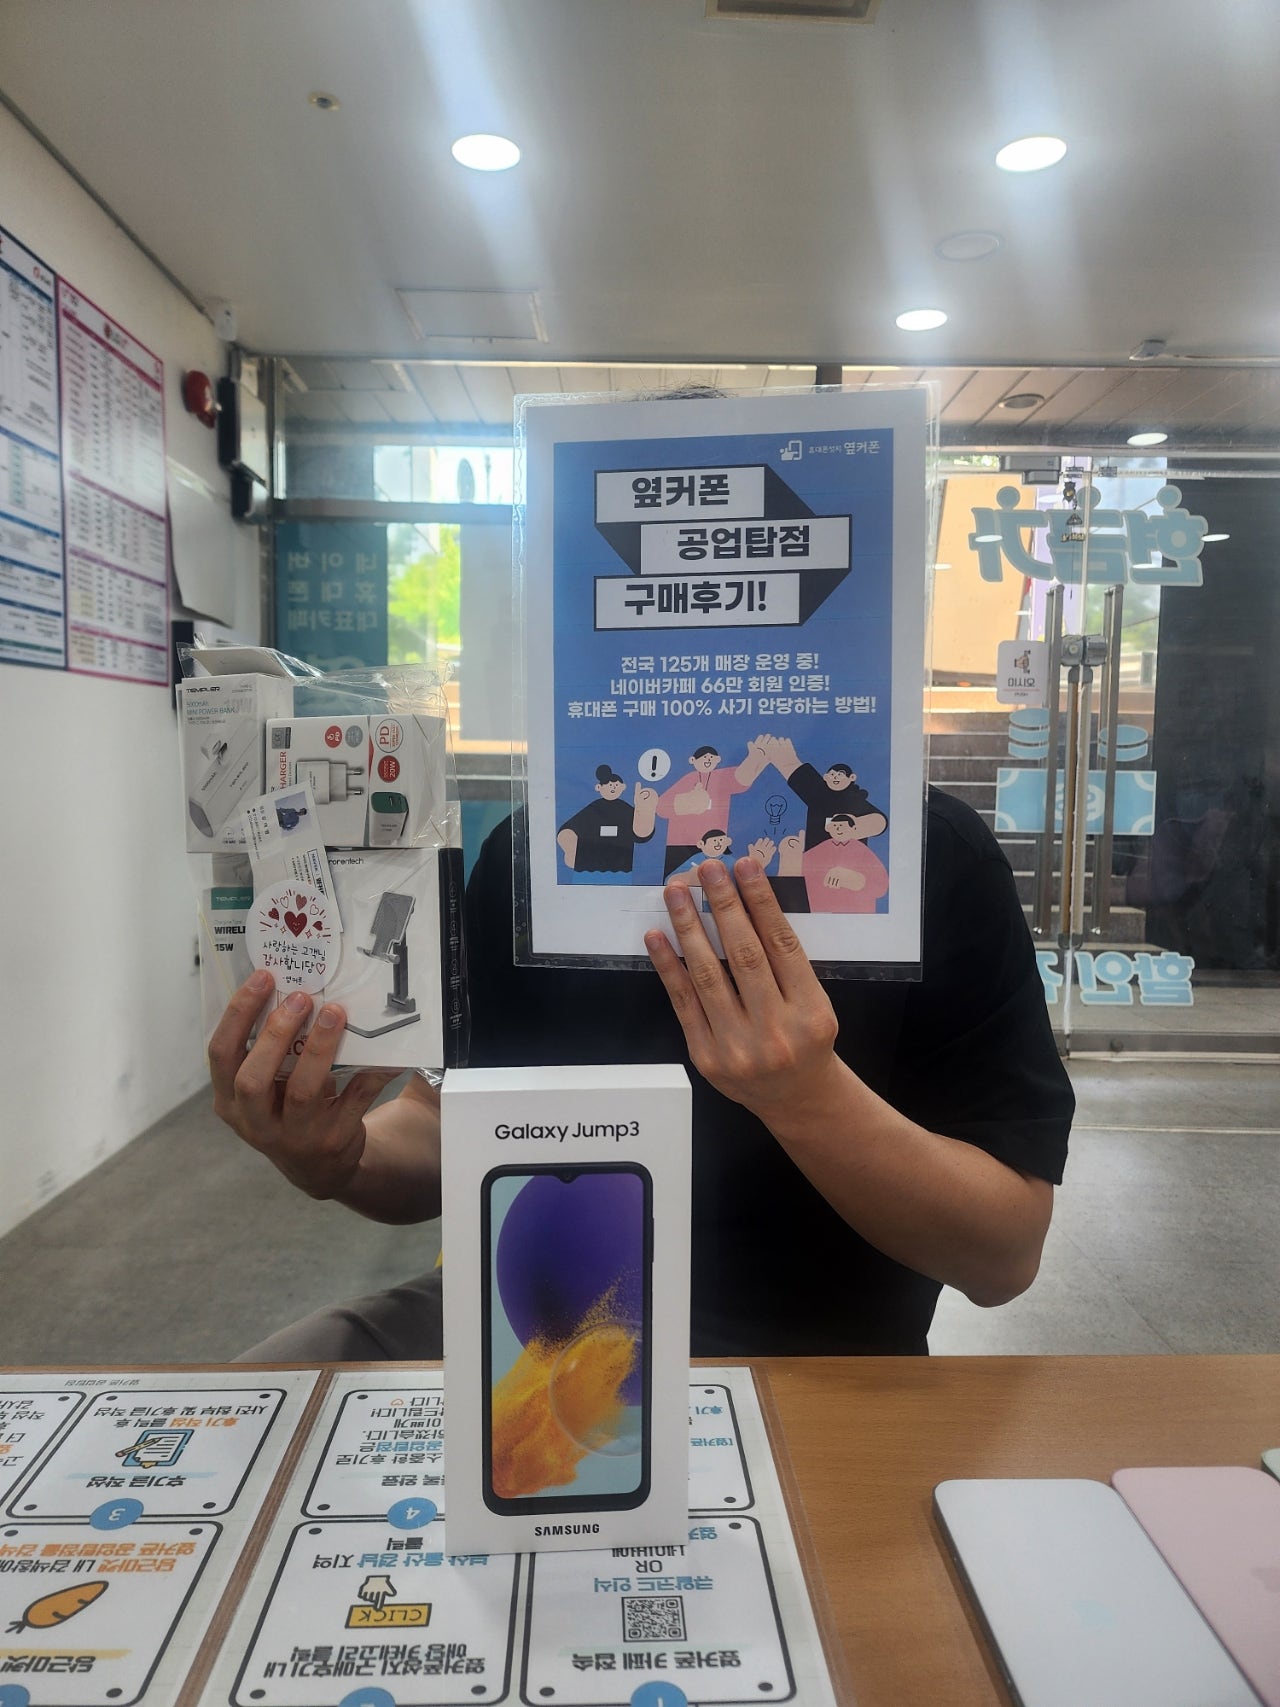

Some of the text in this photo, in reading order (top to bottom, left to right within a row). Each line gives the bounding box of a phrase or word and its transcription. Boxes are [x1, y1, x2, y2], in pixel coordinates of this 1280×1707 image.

[843, 440, 881, 455] 옆커폰
[632, 474, 731, 509] 옆커폰
[677, 525, 811, 561] 공업탑점
[624, 580, 768, 616] 구매후기!
[620, 653, 820, 675] 전국 125개 매장 운영 중!
[610, 675, 831, 697] 네이버카페 66만 회원 인증!
[567, 696, 877, 720] 휴대폰 구매 100% 사기 안당하는 방법!
[379, 726, 390, 746] PD
[279, 751, 287, 791] HARGER
[263, 940, 326, 961] 사랑하는 고객님
[495, 1121, 640, 1143] Galaxy Jump3
[94, 1407, 126, 1418] 작성
[131, 1406, 178, 1417] 후기글
[236, 1405, 268, 1417] 사진
[114, 1418, 132, 1428] 후
[136, 1417, 167, 1428] 클릭
[336, 1453, 443, 1465] 소중한 후기로
[86, 1475, 186, 1488] 후기글 작성
[381, 1474, 418, 1486] 완료
[108, 1508, 126, 1522] 3
[406, 1507, 421, 1520] 4
[534, 1523, 601, 1536] SAMSUNG
[138, 1542, 196, 1556] 옆커폰
[386, 1538, 424, 1551] 클릭
[73, 1559, 97, 1573] 내
[312, 1554, 354, 1568] 지역
[357, 1553, 399, 1567] 경남
[403, 1552, 444, 1567] 울산
[635, 1560, 663, 1574] OR
[593, 1576, 713, 1593] 큐알코드 인식
[357, 1608, 422, 1622] CLICK
[291, 1644, 467, 1662] 해당 카테고리 클릭
[0, 1656, 97, 1674] 당근마켓
[263, 1658, 485, 1678] 옆커폰성지 구매후기 내
[572, 1651, 741, 1671] 옆커폰 카페 접속
